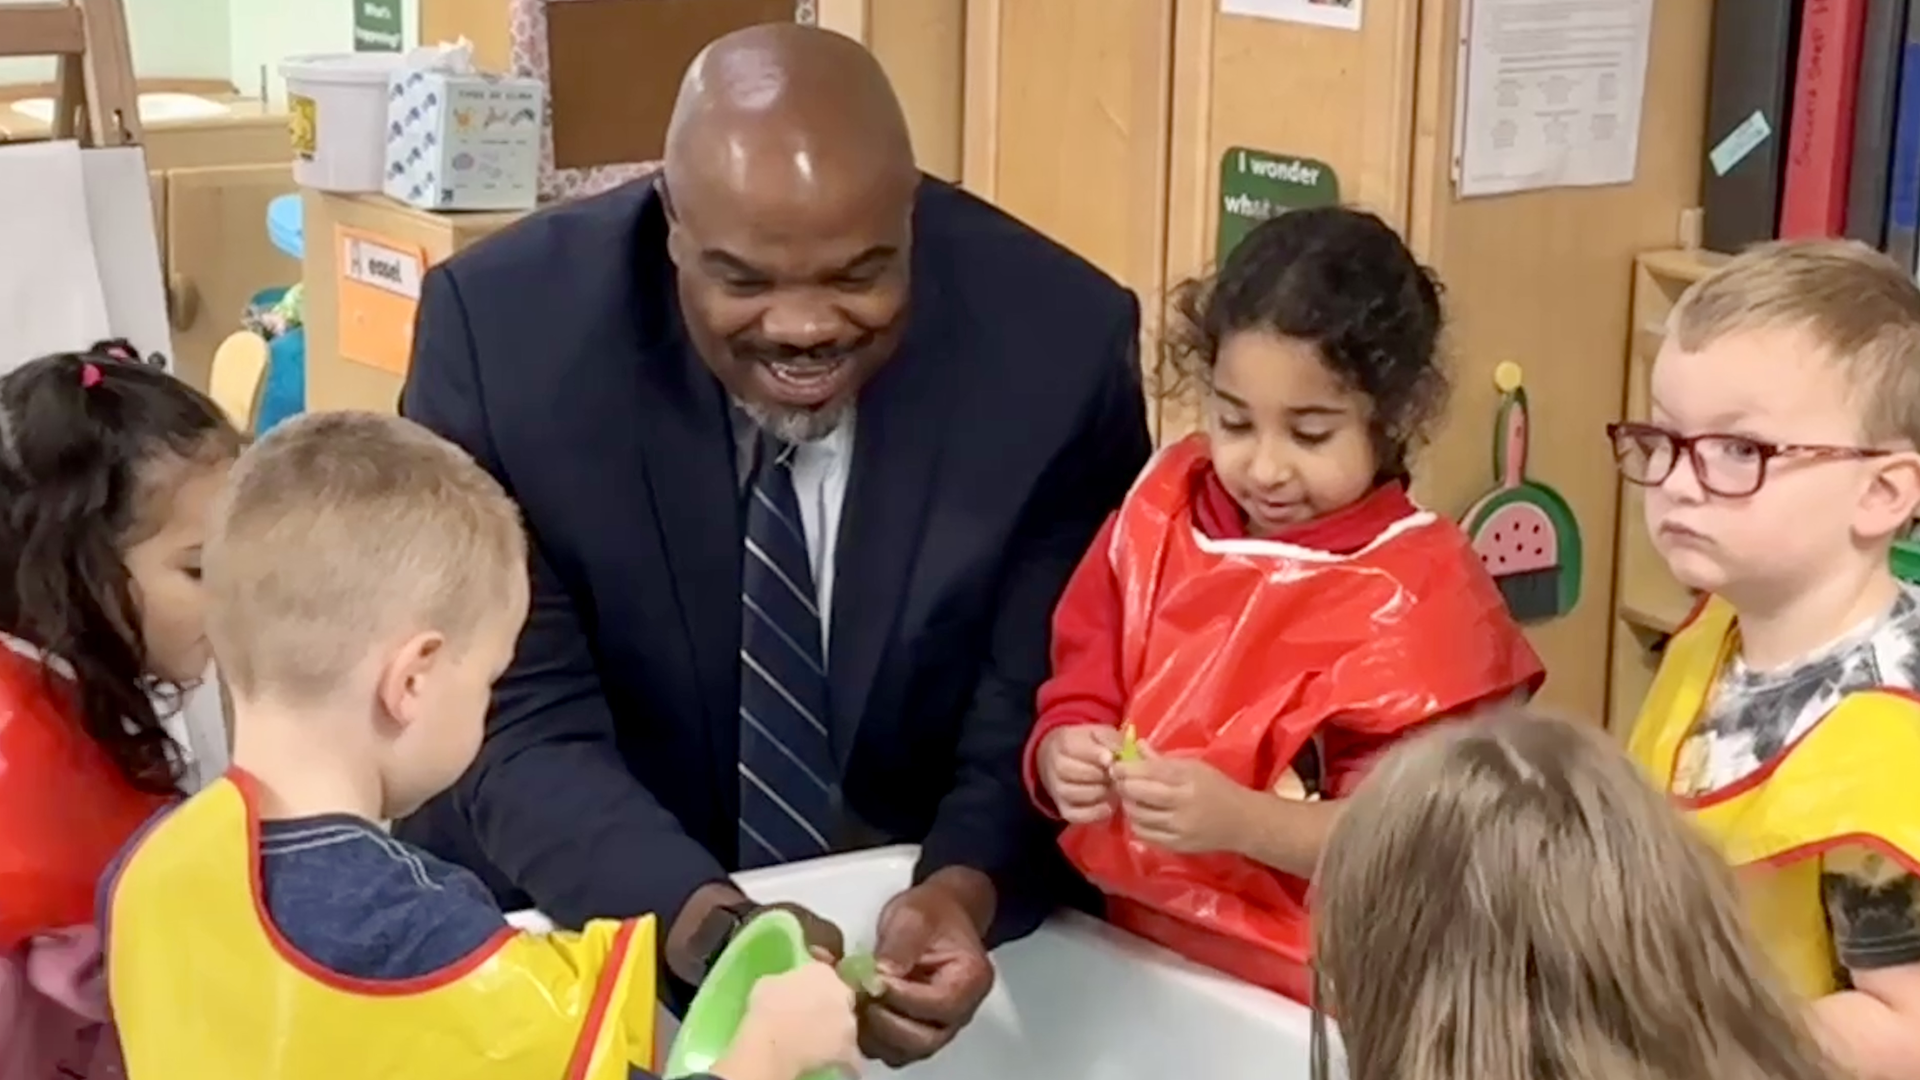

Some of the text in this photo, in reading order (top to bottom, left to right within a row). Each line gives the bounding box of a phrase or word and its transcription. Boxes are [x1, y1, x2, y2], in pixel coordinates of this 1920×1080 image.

[1238, 151, 1320, 186] I wonder
[1224, 193, 1271, 220] what
